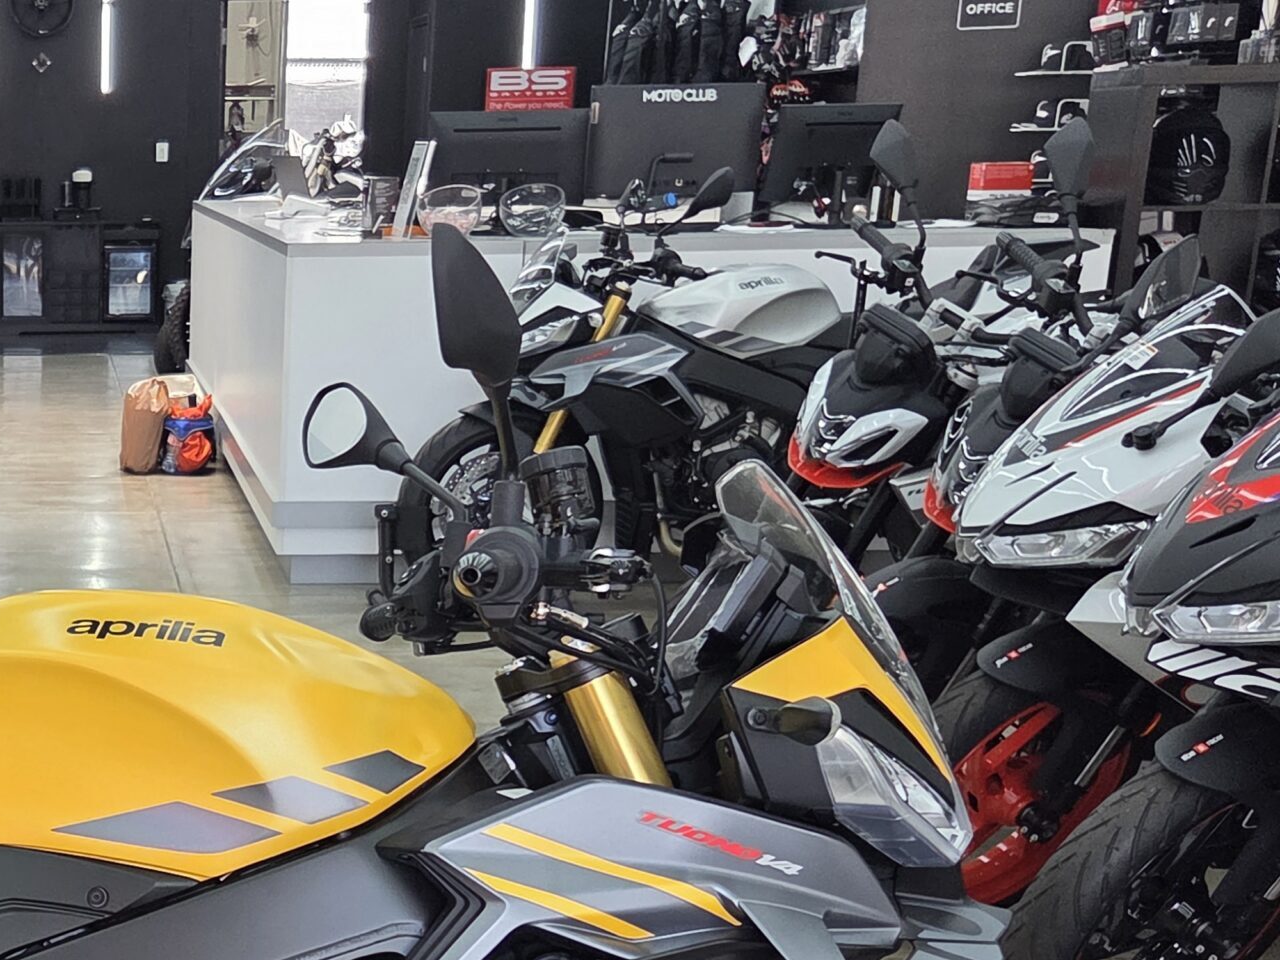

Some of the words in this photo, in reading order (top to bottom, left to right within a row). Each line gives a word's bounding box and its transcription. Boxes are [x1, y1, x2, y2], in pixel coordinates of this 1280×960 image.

[966, 2, 1015, 15] OFFICE
[490, 69, 567, 91] BS
[66, 618, 227, 648] aprilia
[755, 853, 804, 876] V4
